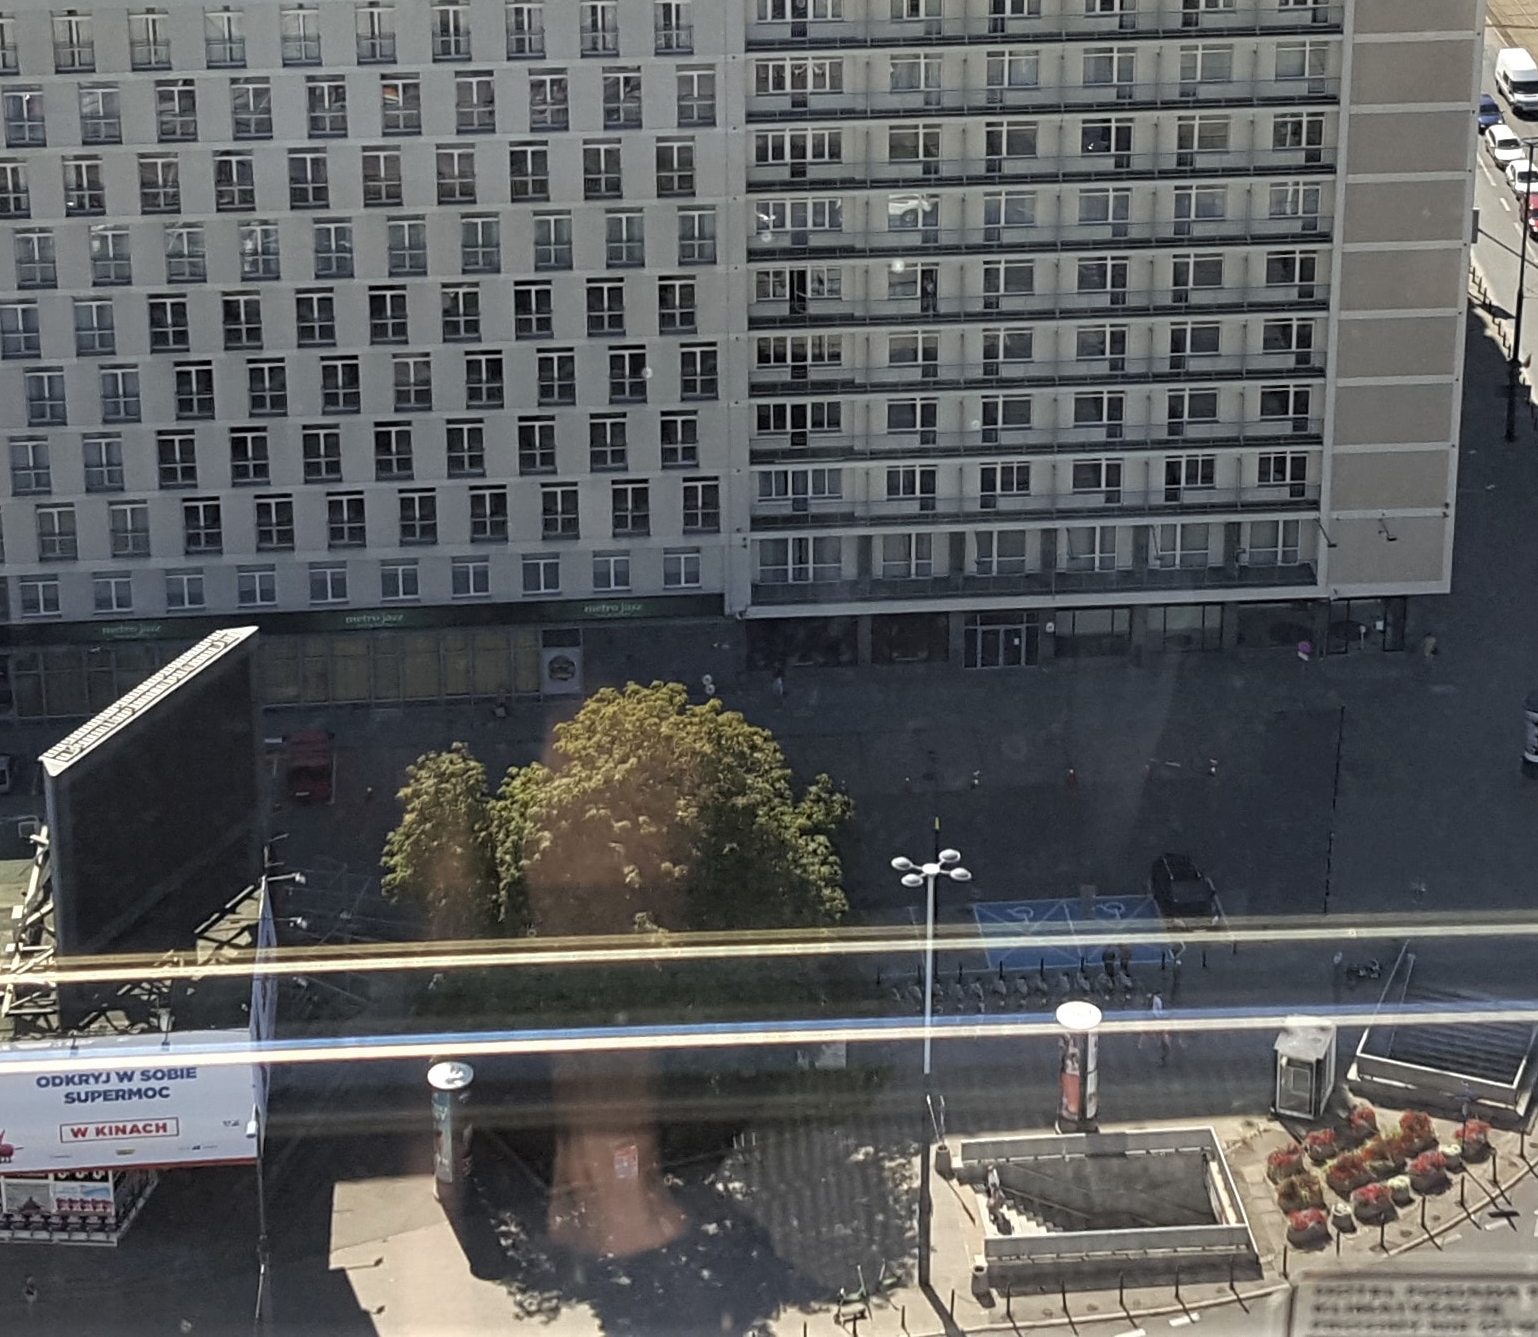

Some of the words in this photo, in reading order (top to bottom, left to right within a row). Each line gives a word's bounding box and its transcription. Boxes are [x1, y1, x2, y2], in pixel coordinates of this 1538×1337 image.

[35, 1071, 111, 1088] ODKRYJ
[114, 1070, 136, 1084] W
[140, 1066, 198, 1083] SOBIE
[63, 1086, 171, 1105] SUPERMOC
[69, 1126, 89, 1139] W
[95, 1121, 168, 1138] KINACH
